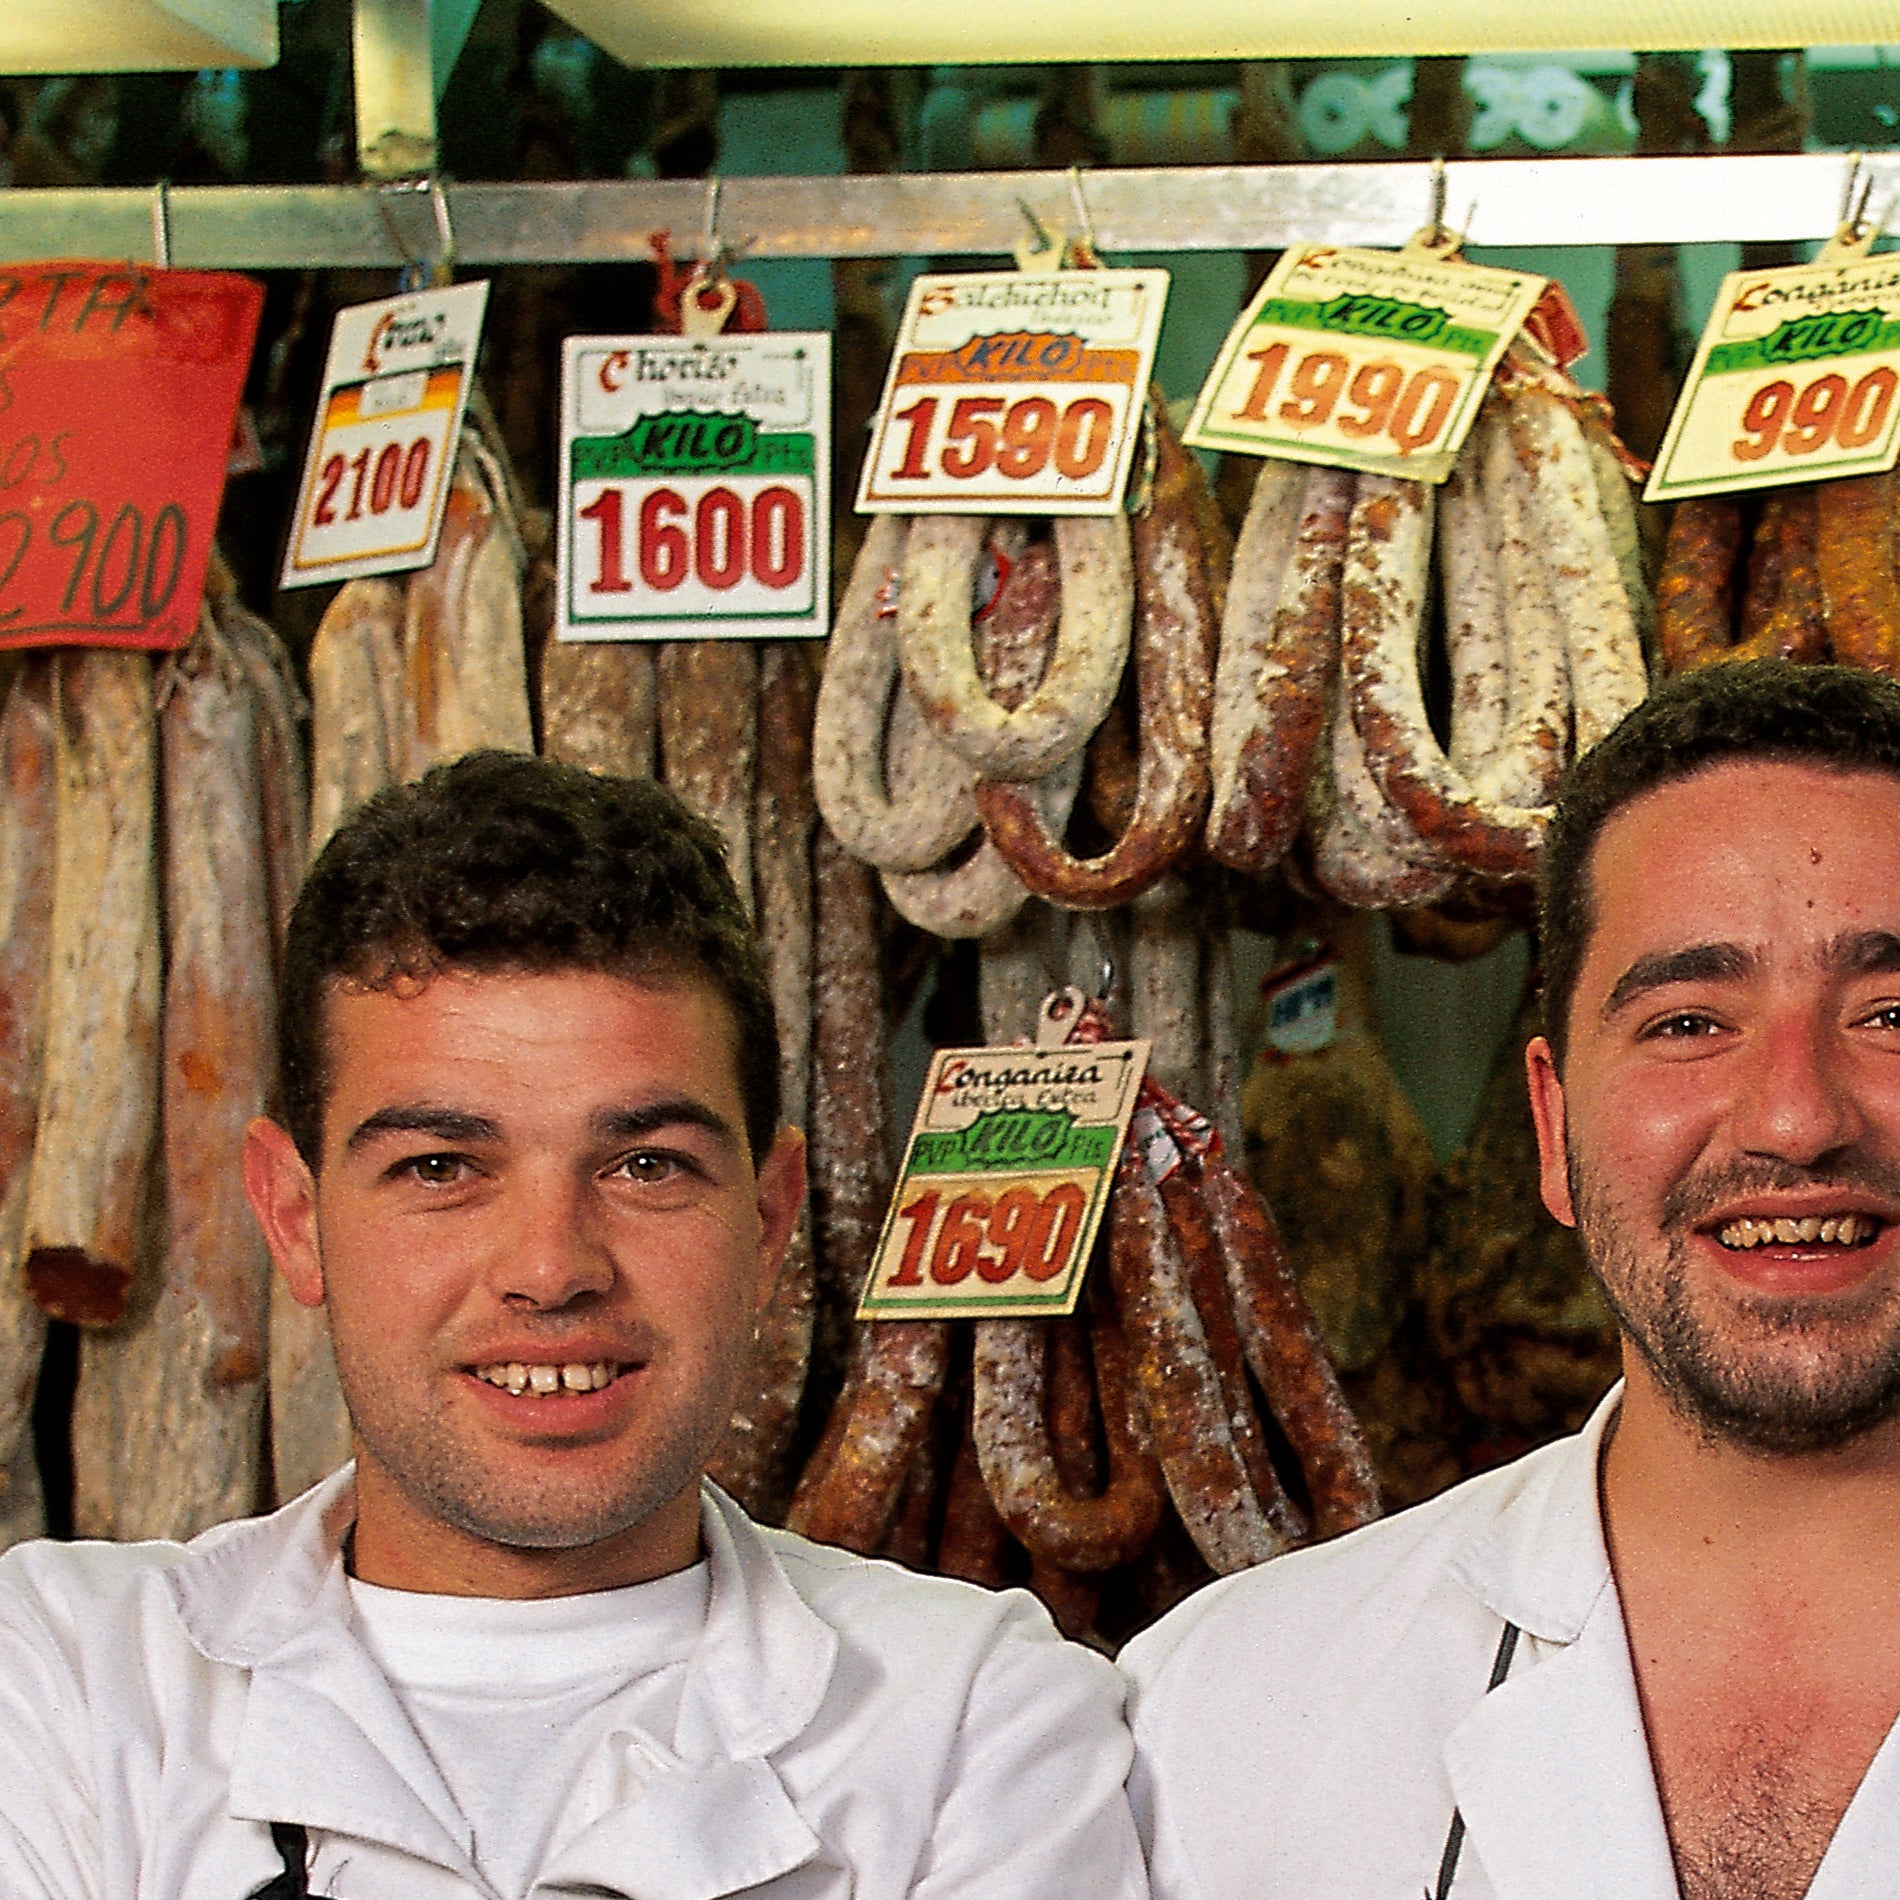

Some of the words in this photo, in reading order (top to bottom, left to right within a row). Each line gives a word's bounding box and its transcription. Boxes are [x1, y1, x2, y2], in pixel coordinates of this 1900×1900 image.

[1328, 301, 1432, 333] KILO
[1772, 318, 1868, 352] KILO
[966, 338, 1073, 368] KILO
[1231, 342, 1460, 458] 1990
[1732, 366, 1899, 463] 990
[642, 422, 744, 458] KILO
[889, 396, 1115, 480] 1590
[314, 436, 431, 528] 2100
[579, 486, 804, 593] 1600
[935, 1059, 1103, 1095] Longaniza
[971, 1117, 1064, 1155] KILO
[886, 1182, 1087, 1287] 1690
